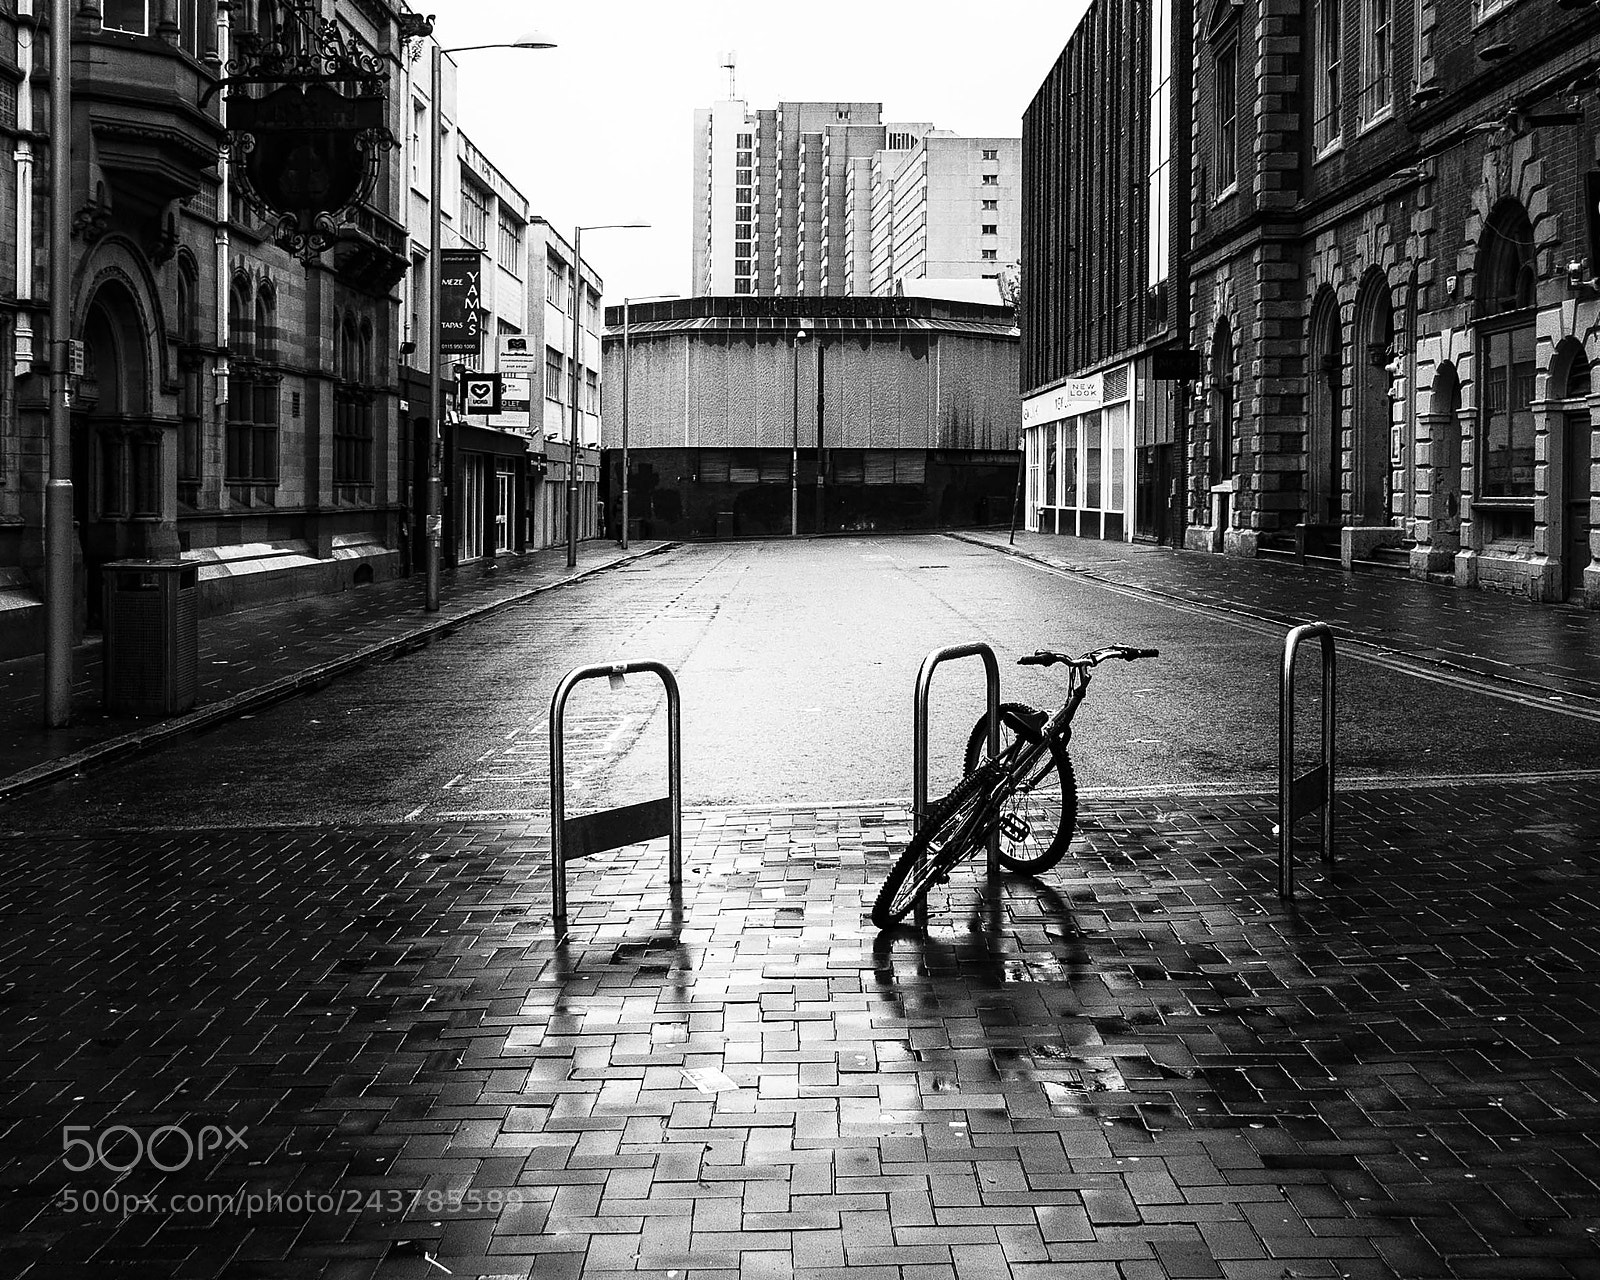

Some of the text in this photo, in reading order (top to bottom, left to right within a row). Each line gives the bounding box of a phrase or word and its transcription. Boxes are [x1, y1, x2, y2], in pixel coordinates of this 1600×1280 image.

[441, 278, 464, 286] MEZE
[464, 271, 480, 336] YAMAS
[441, 321, 464, 329] TAPAS
